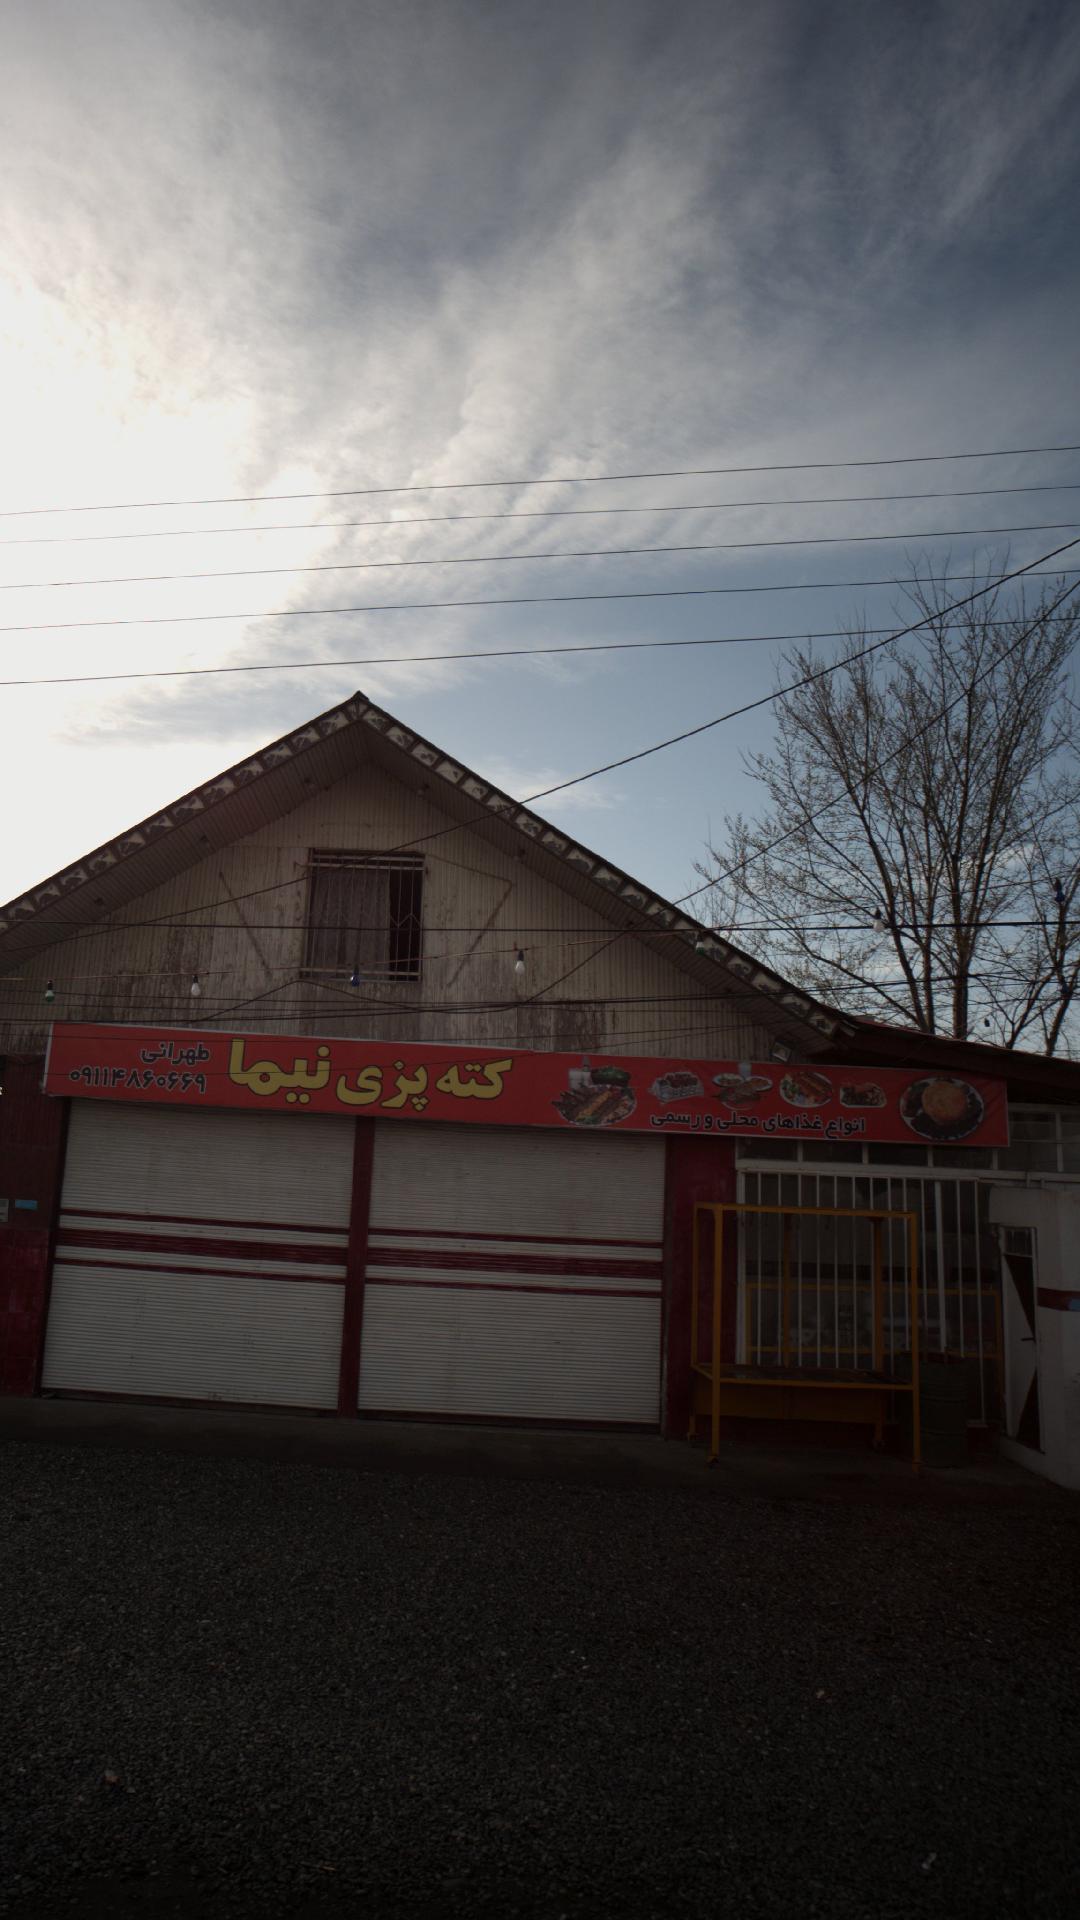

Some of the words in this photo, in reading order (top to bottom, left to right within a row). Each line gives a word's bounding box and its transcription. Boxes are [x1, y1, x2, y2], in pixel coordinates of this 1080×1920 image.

[140, 1041, 210, 1066] طهرانی
[69, 1066, 208, 1094] ۰۹۱۱۴۸۶۰۶۶۹
[229, 1038, 332, 1105] نیما
[436, 1058, 513, 1100] کته
[336, 1060, 430, 1112] پزی
[650, 1111, 702, 1130] رسمی
[703, 1115, 713, 1130] و
[717, 1110, 758, 1129] محلی
[762, 1113, 822, 1132] غذاهای
[824, 1116, 866, 1139] انواع
